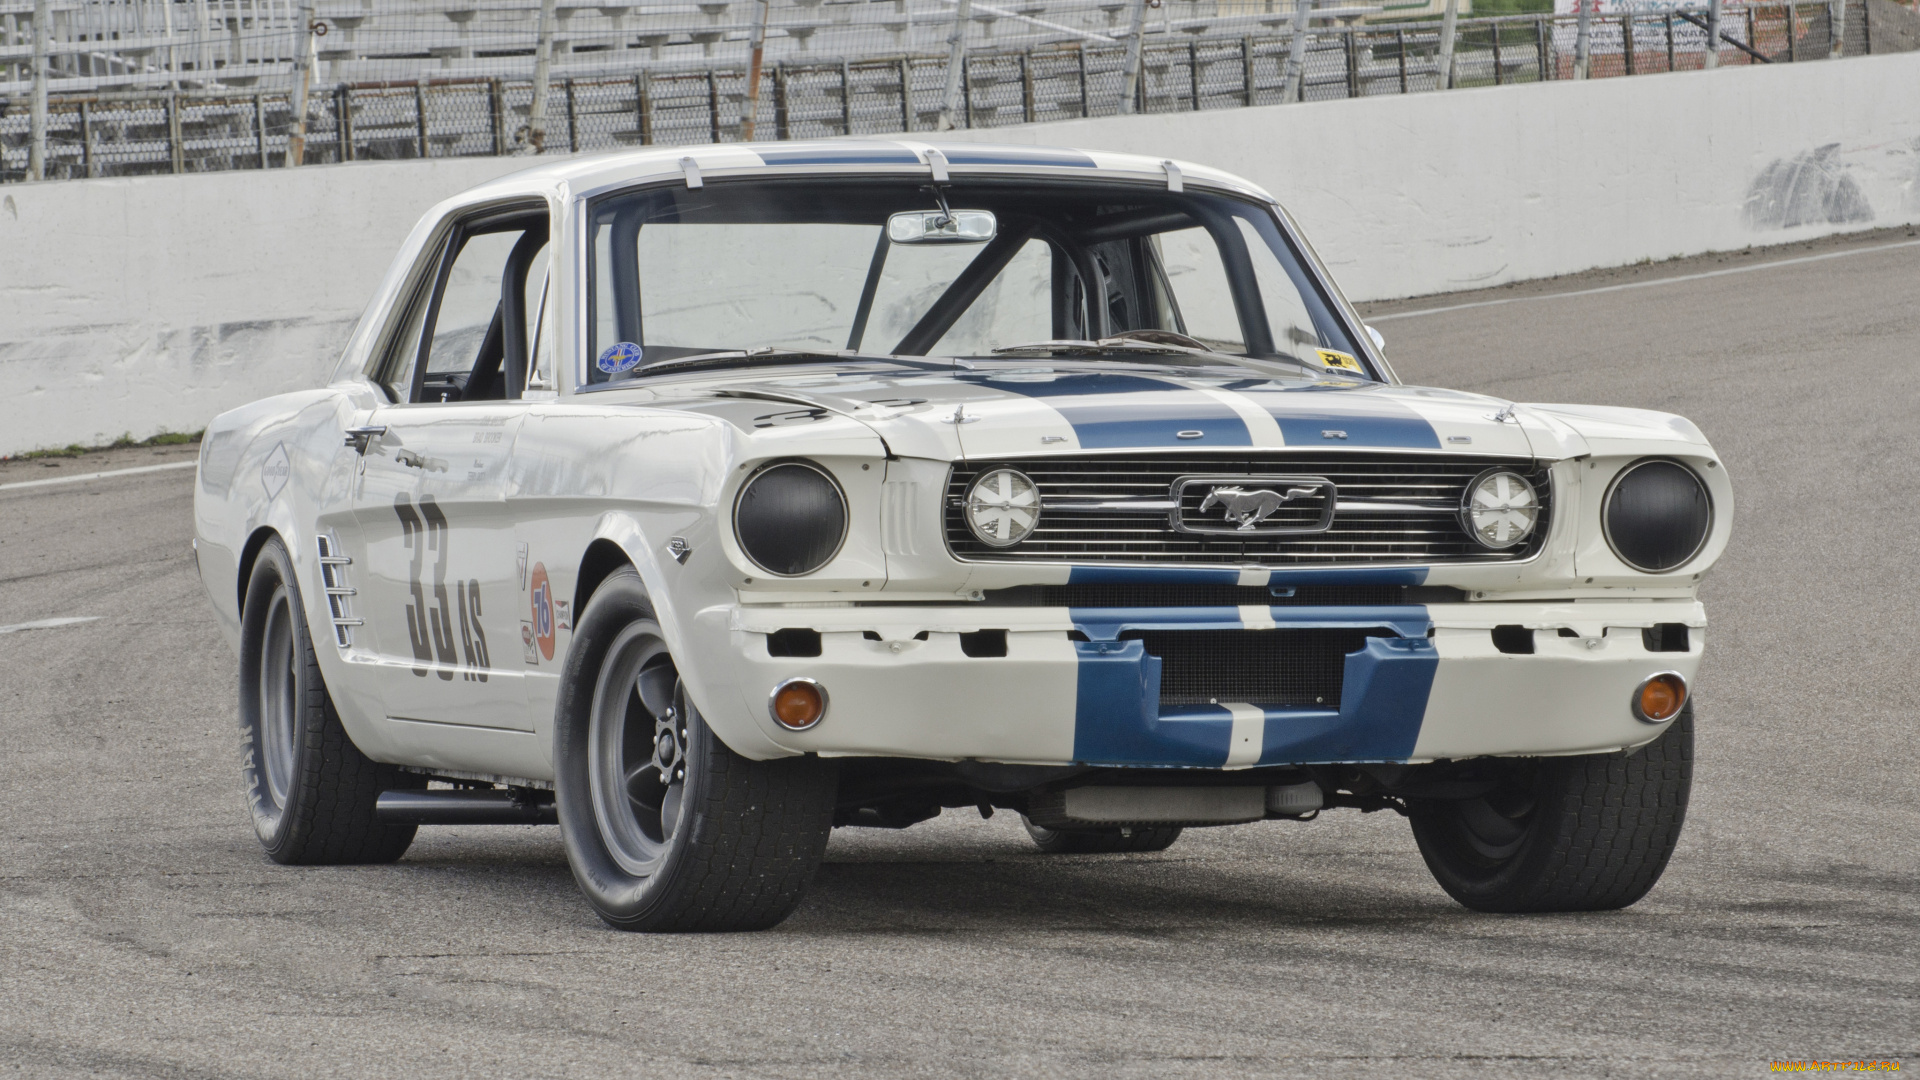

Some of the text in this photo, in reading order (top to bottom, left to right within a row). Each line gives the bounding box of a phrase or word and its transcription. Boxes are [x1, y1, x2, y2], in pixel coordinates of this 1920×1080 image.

[600, 343, 640, 360] MUSTANG CLUB
[607, 360, 637, 372] AMERICA
[394, 491, 491, 683] 33 AS
[533, 581, 551, 638] 76
